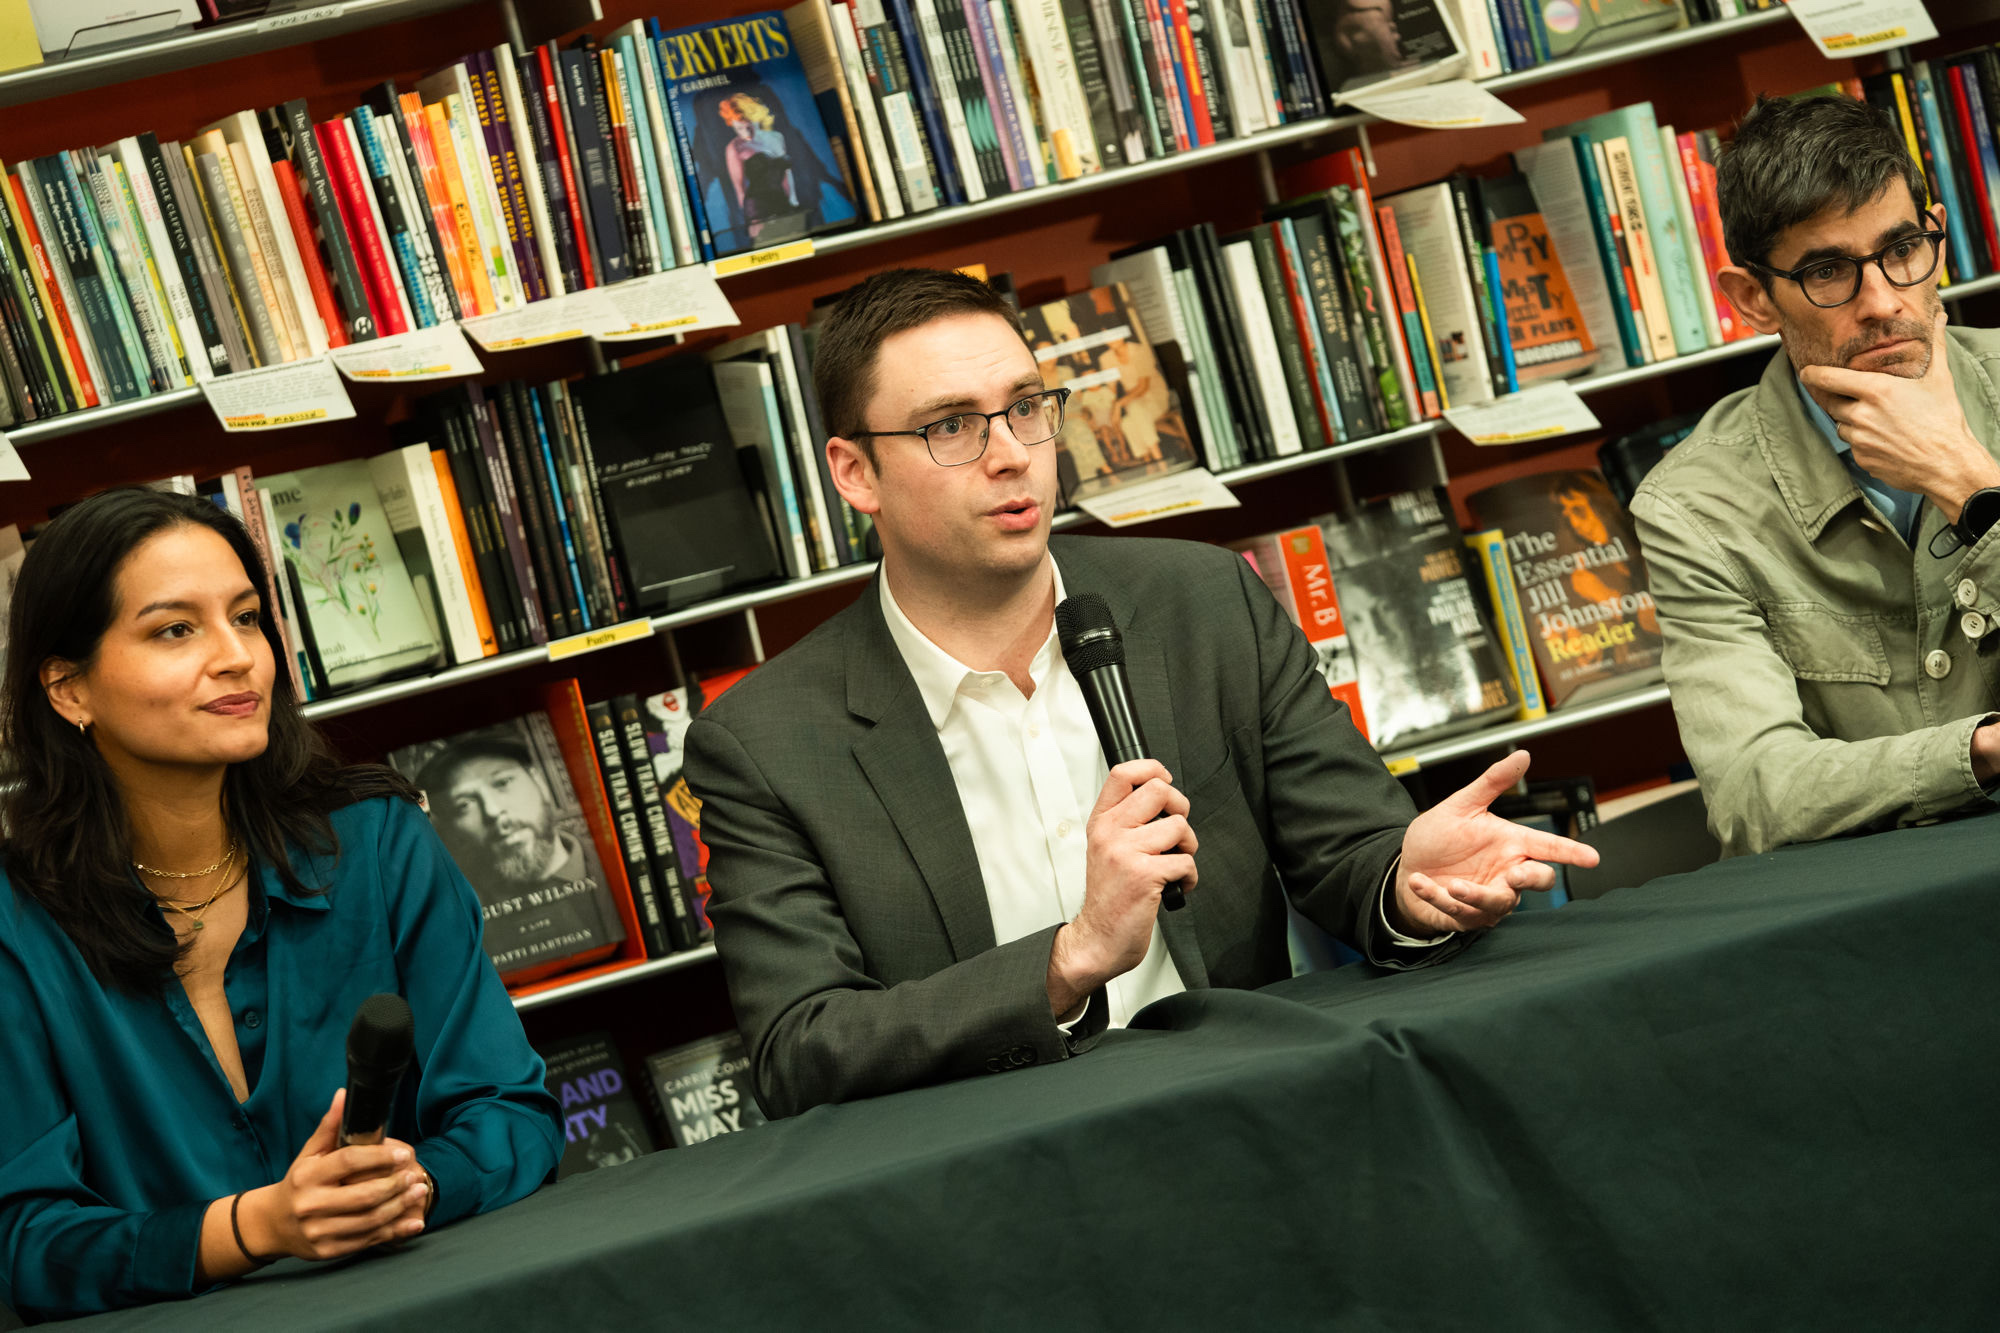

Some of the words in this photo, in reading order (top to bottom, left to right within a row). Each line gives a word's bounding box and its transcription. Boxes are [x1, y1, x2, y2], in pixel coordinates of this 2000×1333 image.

[661, 16, 789, 81] ERVERTS
[680, 74, 731, 94] GABRIEL
[292, 109, 308, 130] The
[298, 129, 323, 179] BreakBeat
[149, 155, 172, 202] LUCILLE
[165, 201, 188, 251] CLIFTON
[314, 178, 331, 205] Poets
[31, 242, 50, 280] Console
[209, 164, 226, 193] DOG
[220, 196, 240, 234] SHOW
[243, 267, 261, 300] BILLY
[255, 303, 280, 357] COLLINS
[749, 250, 780, 265] Poetry
[1315, 234, 1327, 254] THE
[20, 268, 36, 297] MICHAEL
[30, 295, 44, 320] CHANG
[1320, 254, 1341, 308] COLLECTED
[1317, 292, 1338, 335] YEATS
[1334, 310, 1350, 342] POEMS
[1530, 317, 1577, 338] PLAYS
[1514, 338, 1585, 367] BOGOSIAN
[1505, 524, 1559, 562] The
[1512, 534, 1629, 589] Essential
[1301, 560, 1333, 607] Mr.
[1418, 557, 1462, 584] MOVIES
[1426, 595, 1477, 626] PAULINE
[1523, 576, 1569, 613] Jill
[1534, 582, 1656, 640] Johnston
[1312, 605, 1339, 627] B
[1450, 613, 1483, 638] KAEL
[586, 630, 618, 647] Poetry
[1545, 613, 1639, 665] Reader
[597, 728, 622, 768] SLOW
[617, 811, 646, 864] COMING
[623, 721, 649, 762] SLOW
[644, 804, 673, 857] COMING
[480, 896, 525, 921] GUST
[526, 875, 598, 907] WILSON
[491, 946, 527, 965] PATTI
[528, 928, 592, 954] HARTIGAN
[557, 1065, 625, 1109] AND
[661, 1068, 710, 1094] CARRIE
[668, 1077, 742, 1121] MISS
[678, 1105, 745, 1146] MAY
